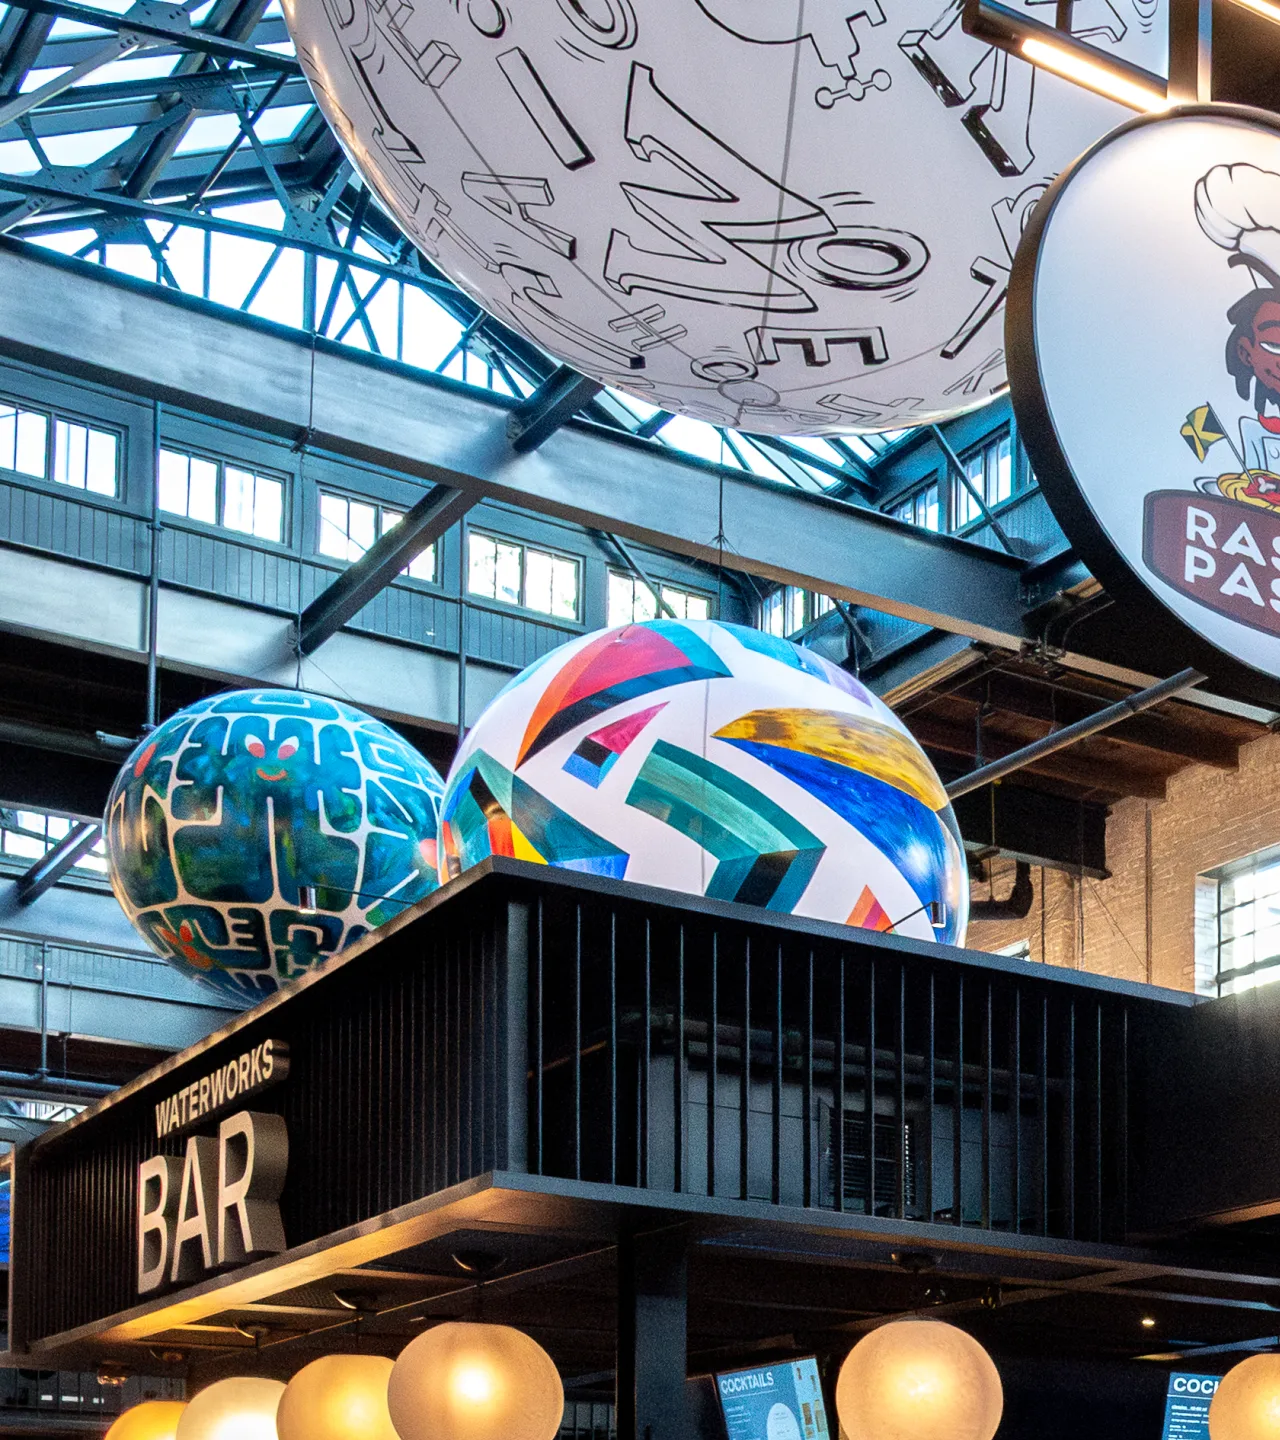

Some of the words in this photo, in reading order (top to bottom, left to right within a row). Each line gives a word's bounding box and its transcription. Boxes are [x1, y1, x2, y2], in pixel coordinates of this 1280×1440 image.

[155, 1038, 274, 1139] WATERWORKS
[137, 1110, 255, 1295] BAR
[720, 1372, 775, 1395] COCKTAILS
